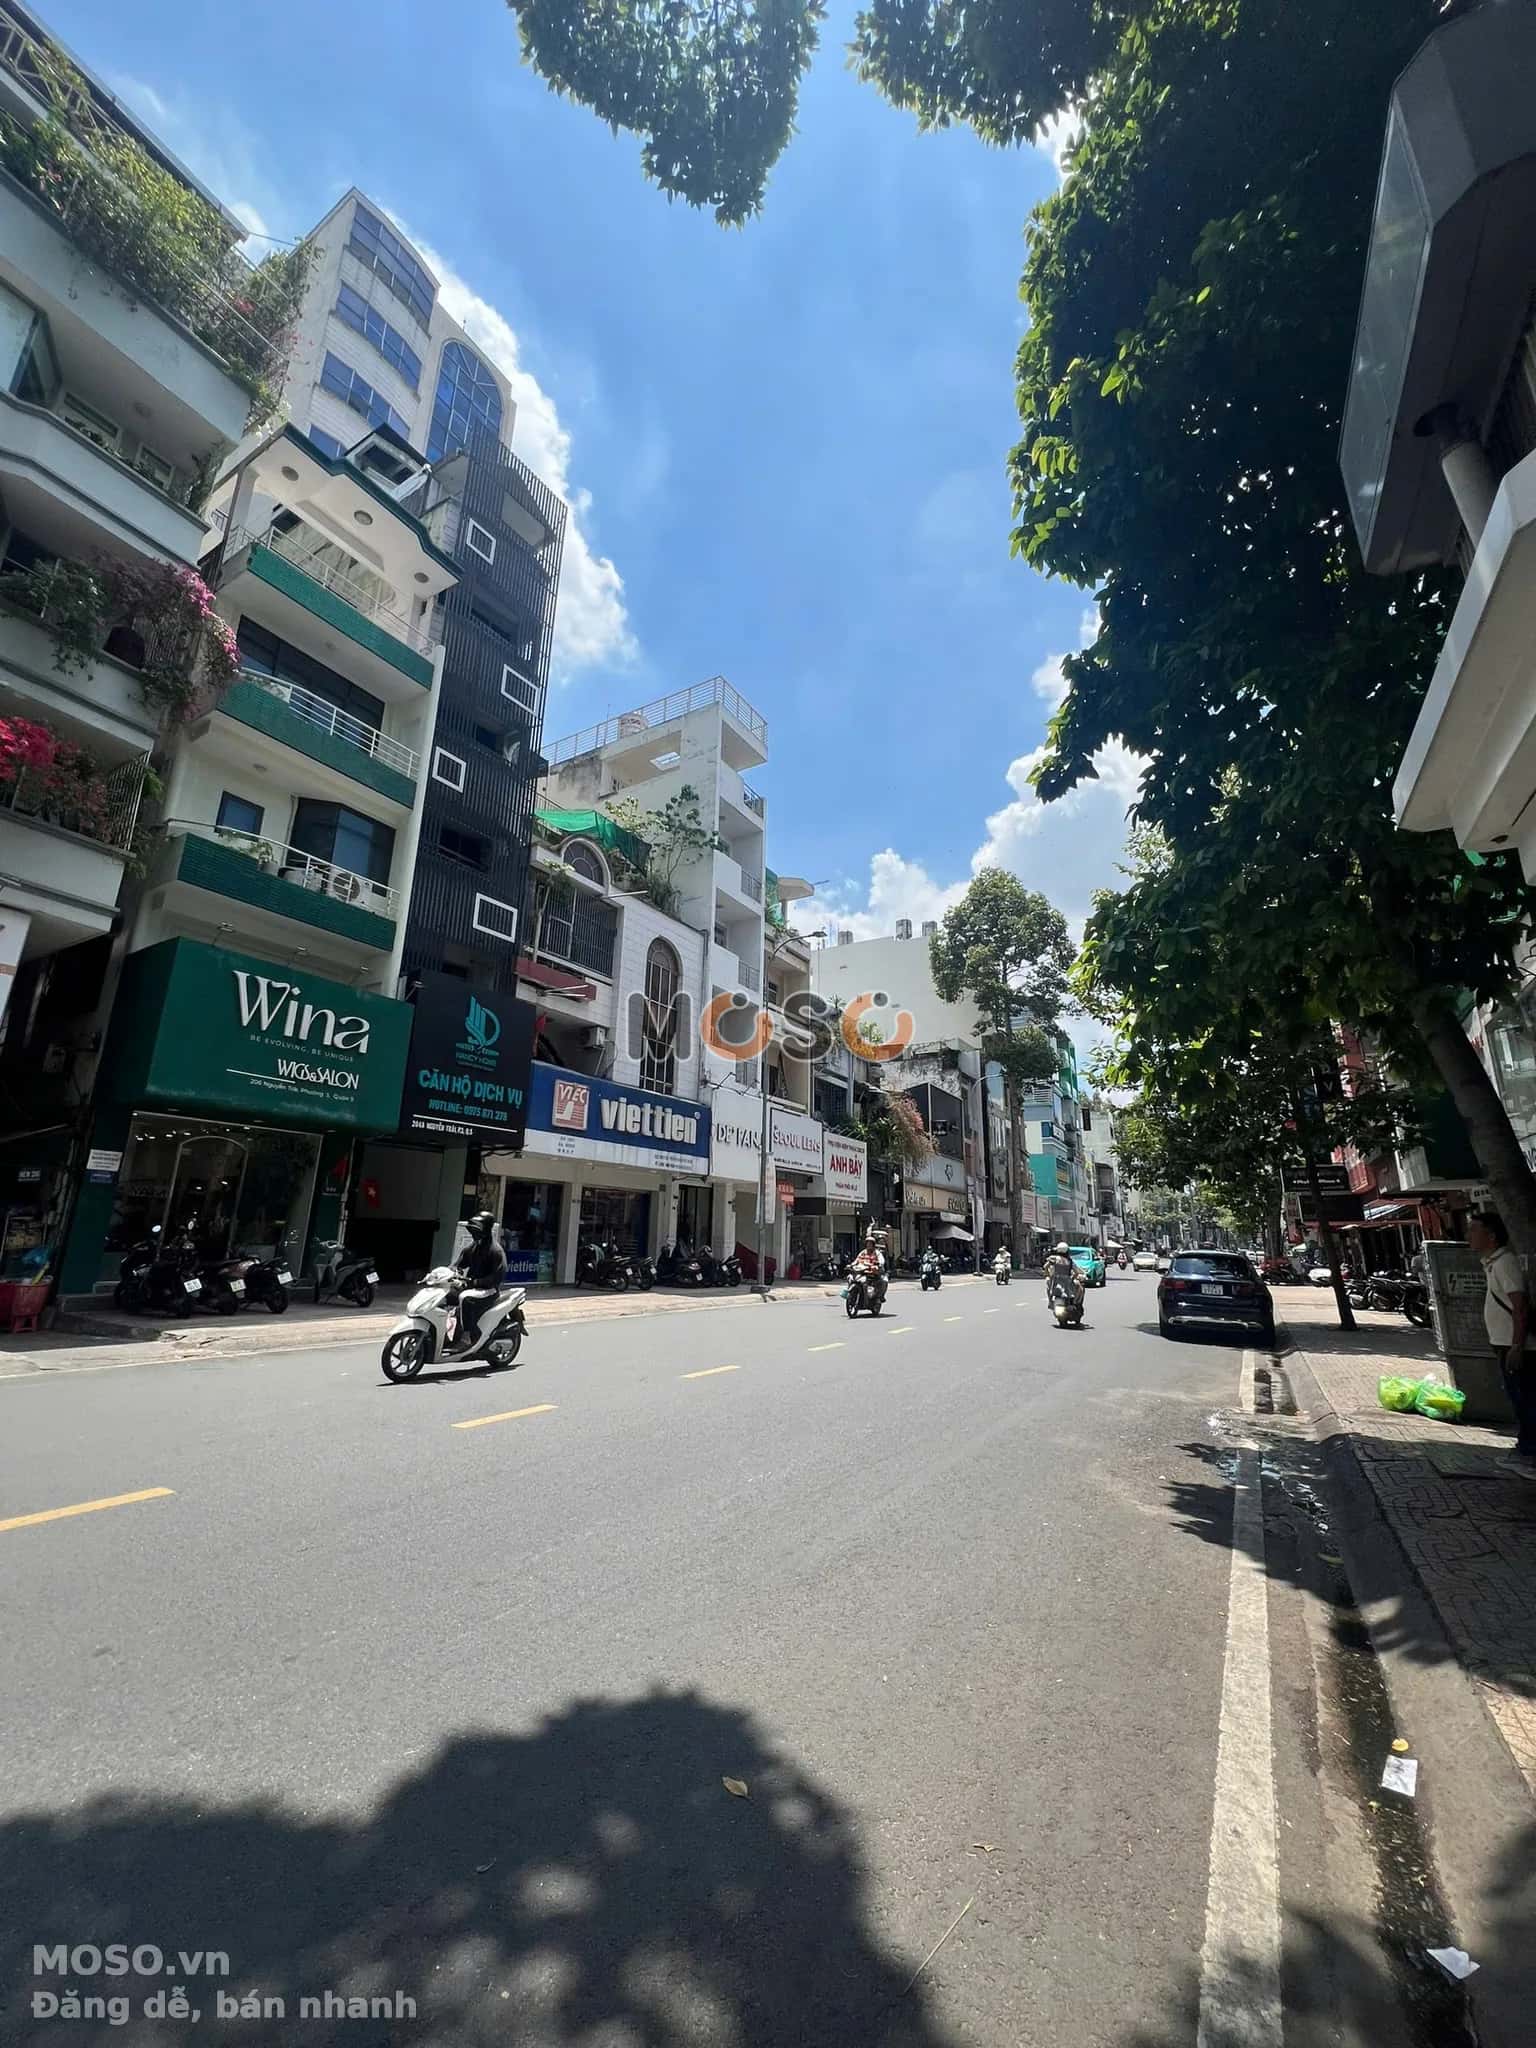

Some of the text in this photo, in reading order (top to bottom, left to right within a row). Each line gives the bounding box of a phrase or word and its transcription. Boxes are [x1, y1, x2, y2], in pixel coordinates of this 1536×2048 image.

[232, 970, 370, 1054] Wina
[249, 1034, 261, 1043] BE
[418, 1068, 523, 1109] CĂN HỘ DỊCH VỤ
[830, 1153, 848, 1175] ANH
[848, 1154, 864, 1177] BẢY
